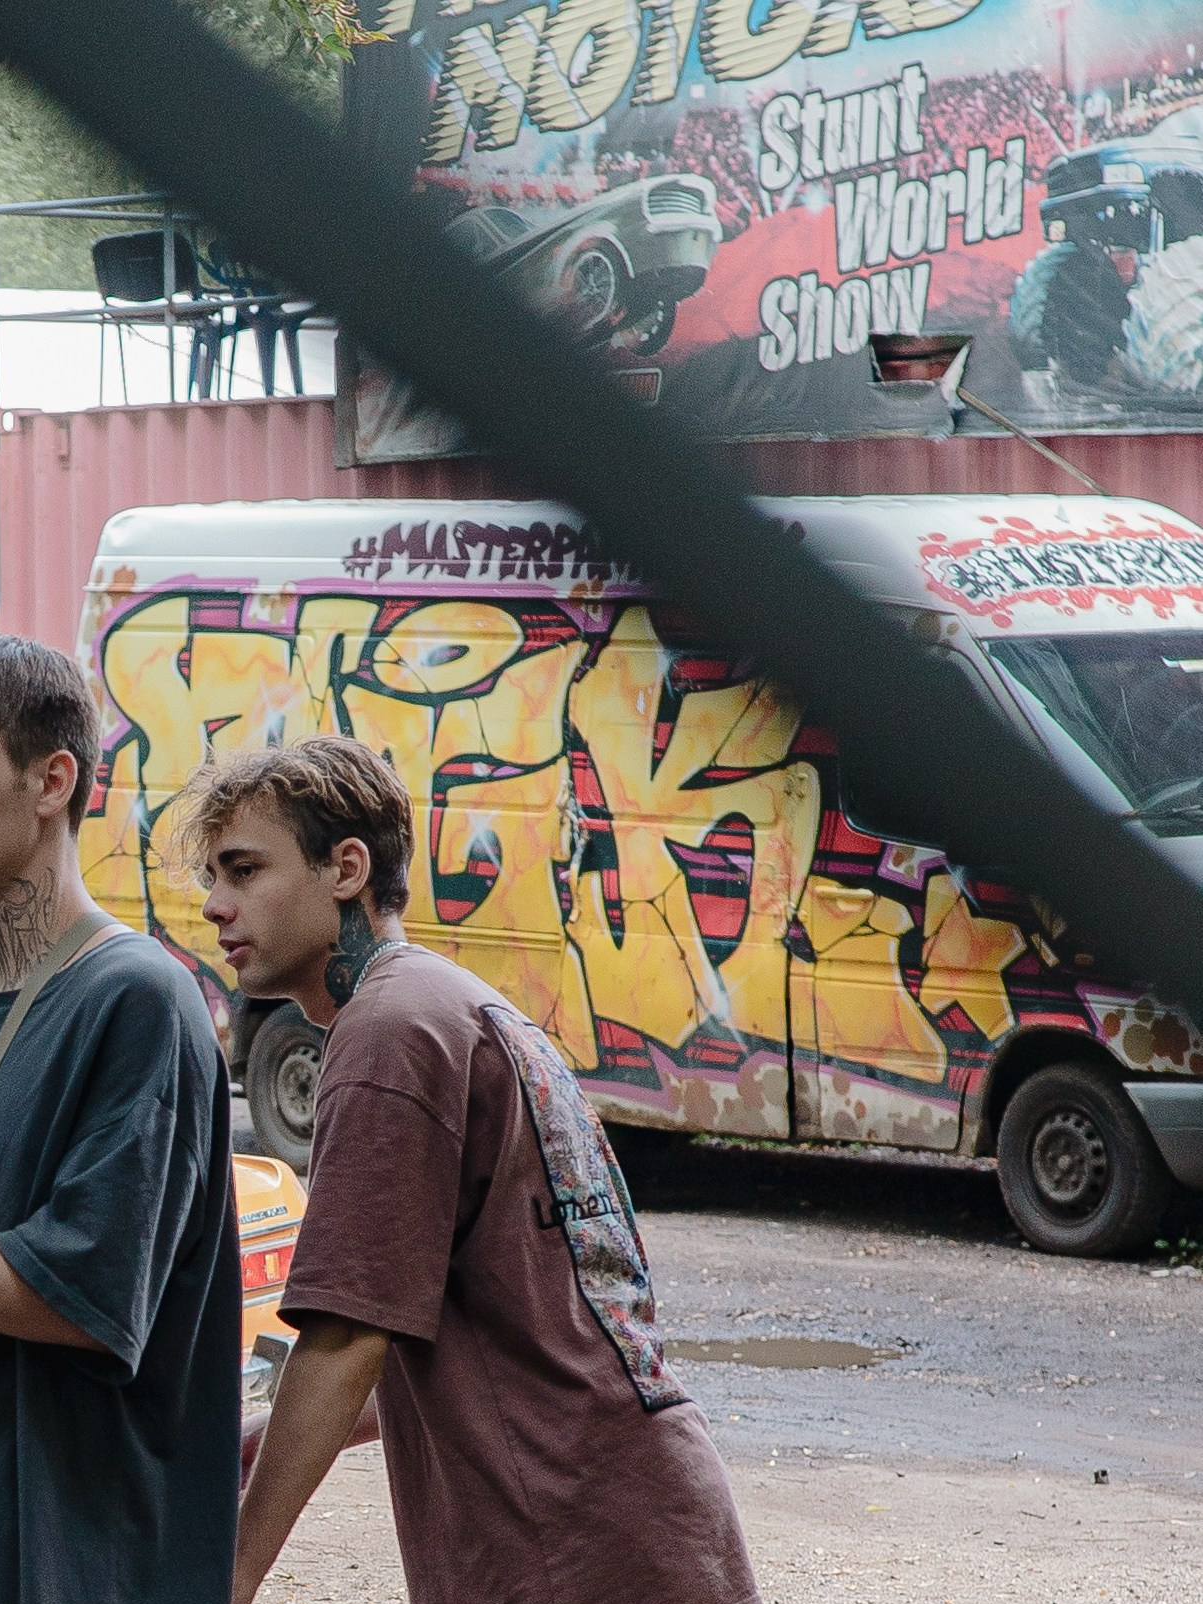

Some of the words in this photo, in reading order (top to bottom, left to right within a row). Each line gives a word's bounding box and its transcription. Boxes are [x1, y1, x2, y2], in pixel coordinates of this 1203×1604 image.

[759, 62, 927, 192] Stunt
[834, 135, 1025, 276] World
[758, 258, 932, 372] Show
